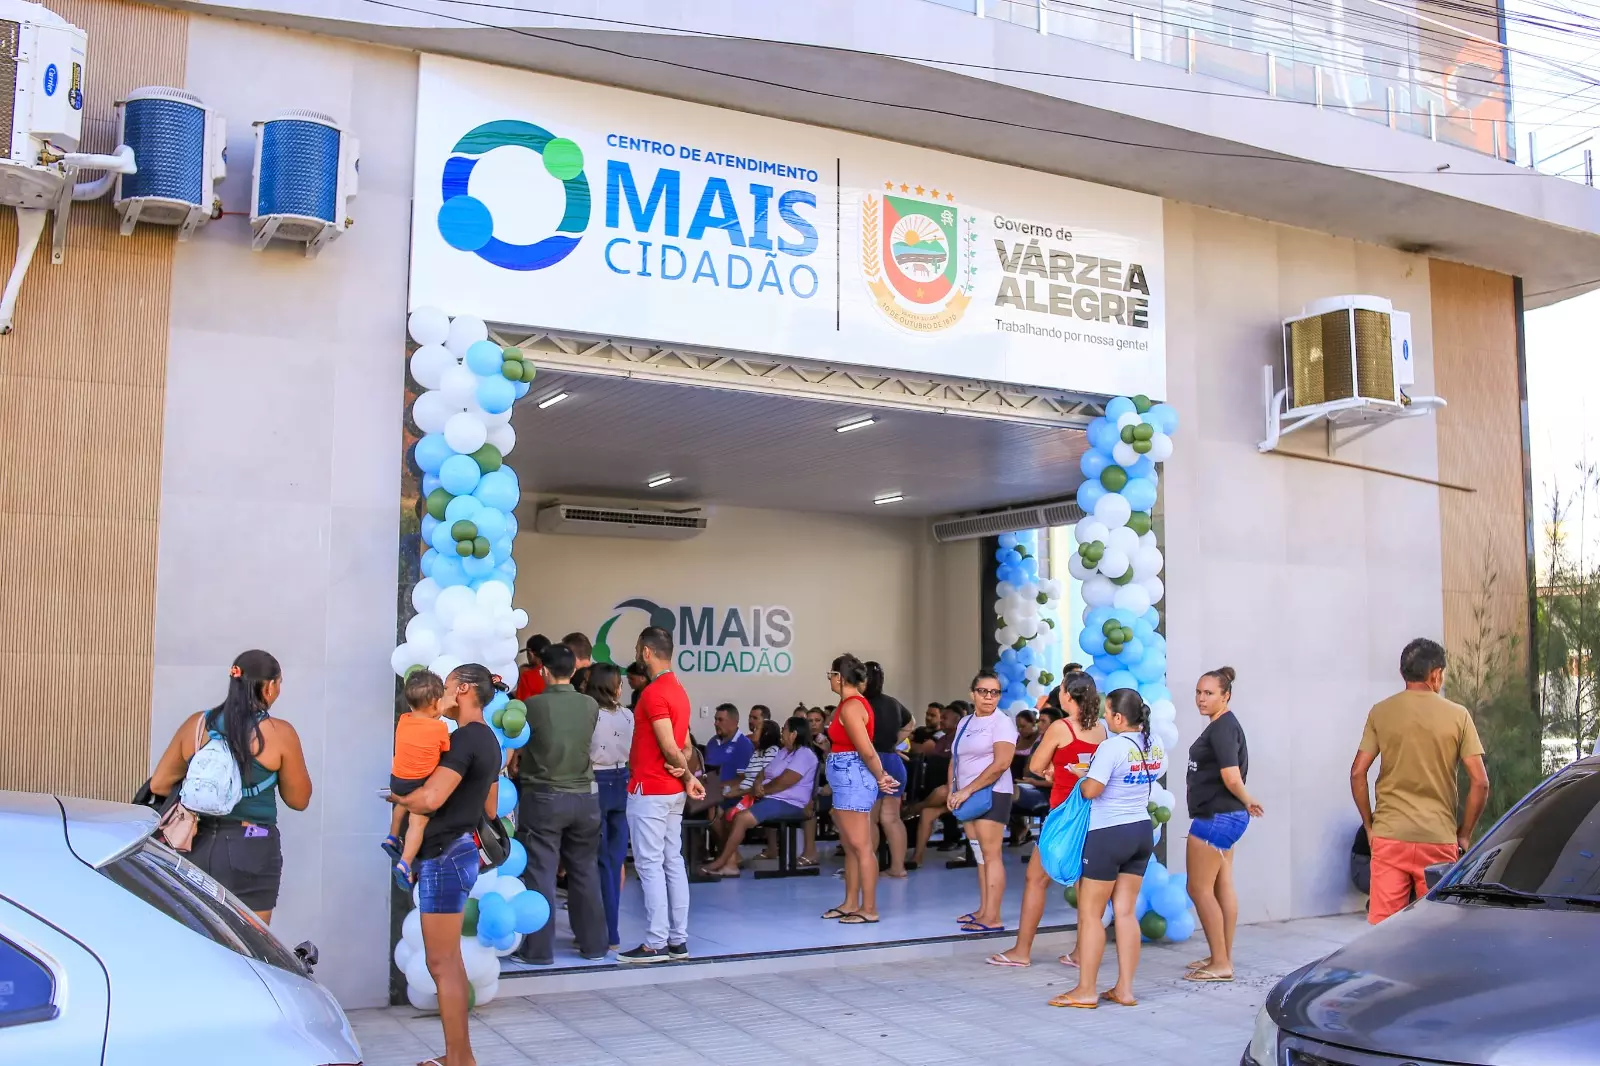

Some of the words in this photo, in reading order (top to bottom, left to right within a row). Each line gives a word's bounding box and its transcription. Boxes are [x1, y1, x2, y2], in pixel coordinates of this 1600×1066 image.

[606, 133, 675, 157] CENTRO
[680, 145, 701, 162] DE
[704, 151, 818, 183] ATENDIMENTO
[605, 159, 819, 257] MAIS
[993, 215, 1053, 240] Governo
[1055, 227, 1073, 242] de
[604, 237, 819, 299] CIDADÃO
[993, 238, 1151, 296] VÁRZEA
[889, 310, 899, 319] DE
[899, 316, 932, 330] OUTUBRO
[994, 276, 1149, 329] ALEGRE
[995, 318, 1062, 340] Trabalhando
[1064, 330, 1082, 343] por
[1083, 334, 1114, 347] nossa
[1116, 337, 1149, 352] gente!
[679, 606, 792, 648] MAIS
[678, 648, 792, 673] CIDADÃO
